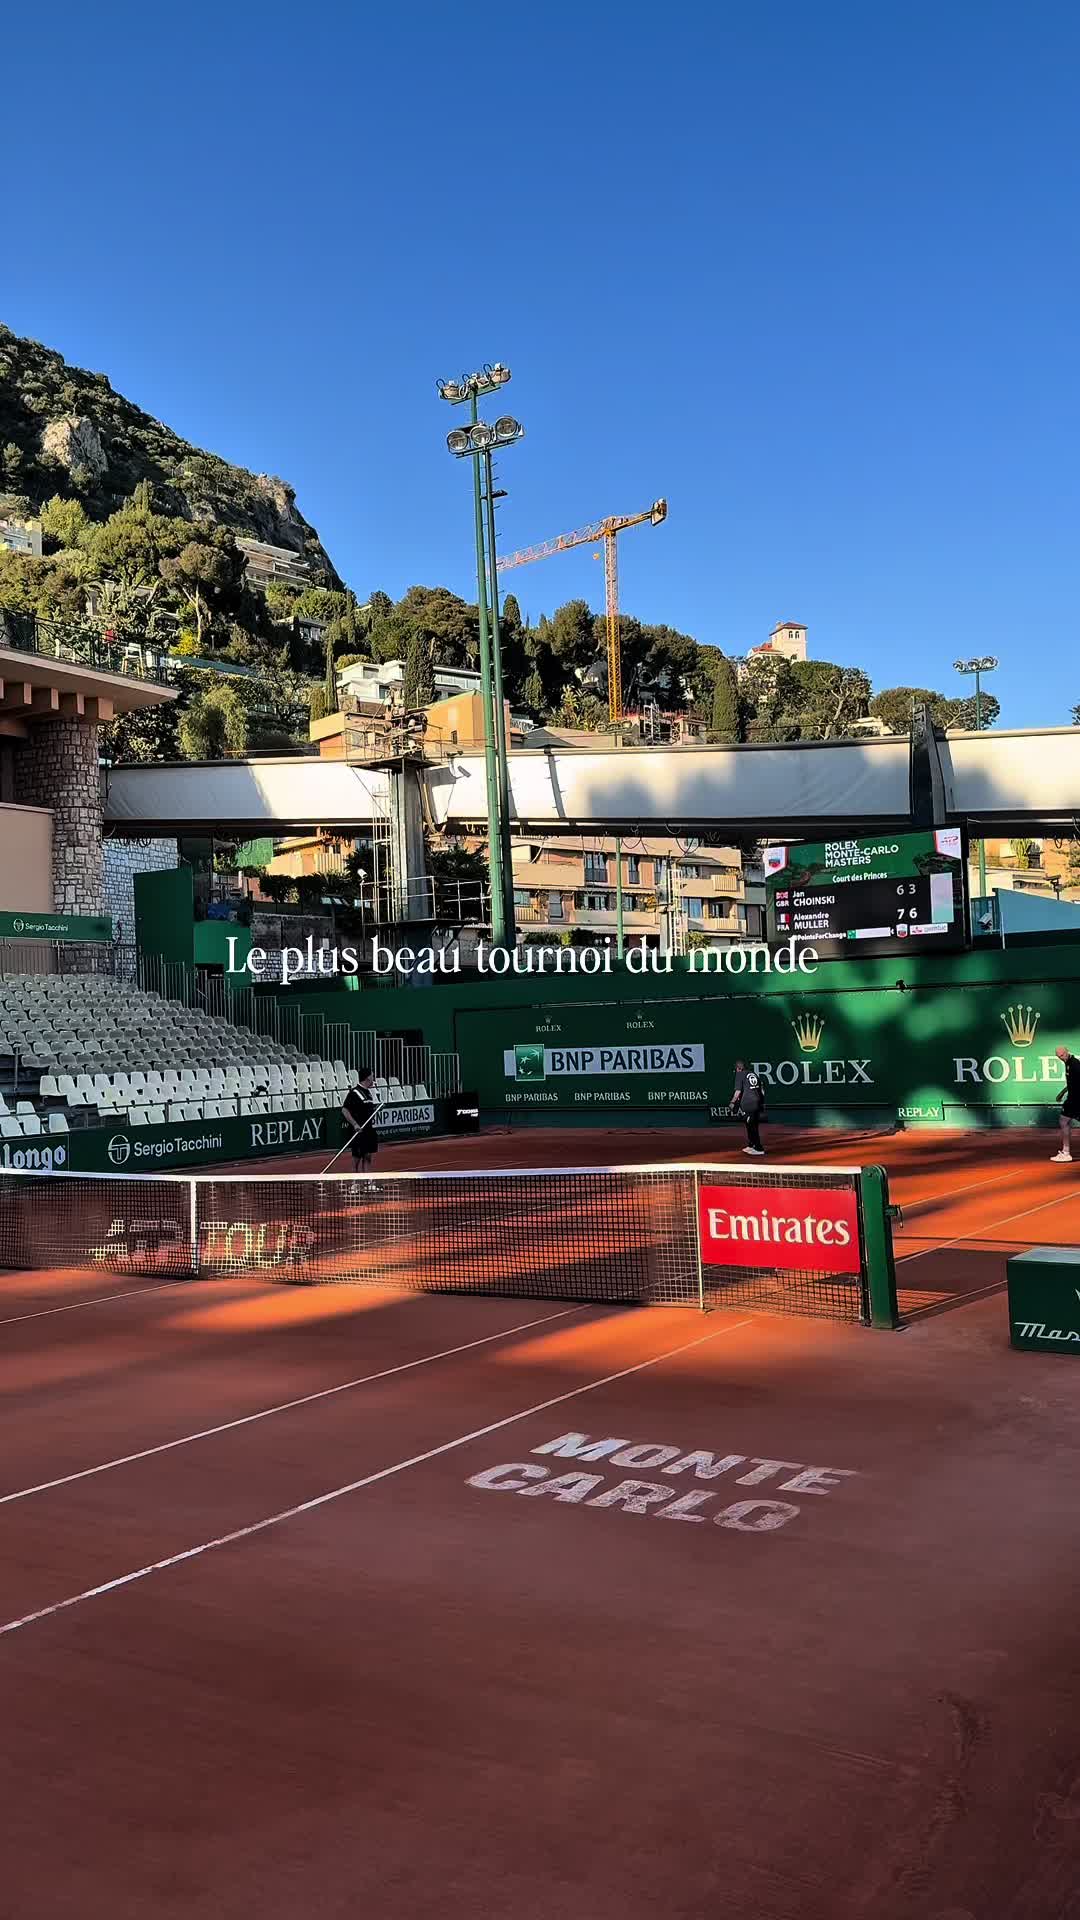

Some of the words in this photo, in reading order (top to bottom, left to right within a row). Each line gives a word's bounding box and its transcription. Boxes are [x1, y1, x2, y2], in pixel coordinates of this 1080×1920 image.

[825, 840, 858, 851] ROLEX
[825, 844, 899, 860] MONTE-CARLO
[825, 856, 871, 868] MASTERS
[832, 874, 851, 883] Court
[851, 873, 862, 882] des
[864, 872, 888, 881] Princes
[793, 890, 805, 898] Jan
[896, 884, 905, 895] 6
[908, 884, 916, 894] 3
[793, 896, 835, 907] CHOINSKI
[897, 908, 905, 920] 7
[909, 908, 917, 918] 6
[25, 923, 44, 931] Sergio
[794, 920, 829, 930] MULLER
[626, 1021, 655, 1029] ROLEX
[551, 1051, 594, 1072] BNP
[600, 1047, 694, 1071] PARIBAS
[751, 1060, 874, 1085] ROLEX
[953, 1055, 1067, 1083] ROLE
[523, 1093, 558, 1101] PARIBAS
[574, 1093, 592, 1101] BNP
[593, 1092, 631, 1100] PARIBAS
[647, 1092, 666, 1100] BNP
[668, 1091, 708, 1100] PARIBAS
[391, 1107, 430, 1123] PARIBAS
[710, 1107, 745, 1116] REPLA
[898, 1107, 940, 1117] REPLAY
[251, 1117, 324, 1147] REPLAY
[134, 1140, 173, 1157] Sergio
[174, 1134, 222, 1152] Tacchini
[707, 1208, 850, 1246] Emirates
[200, 1221, 315, 1269] TOUR
[529, 1432, 859, 1496] MONTE
[465, 1463, 801, 1533] CARLO
